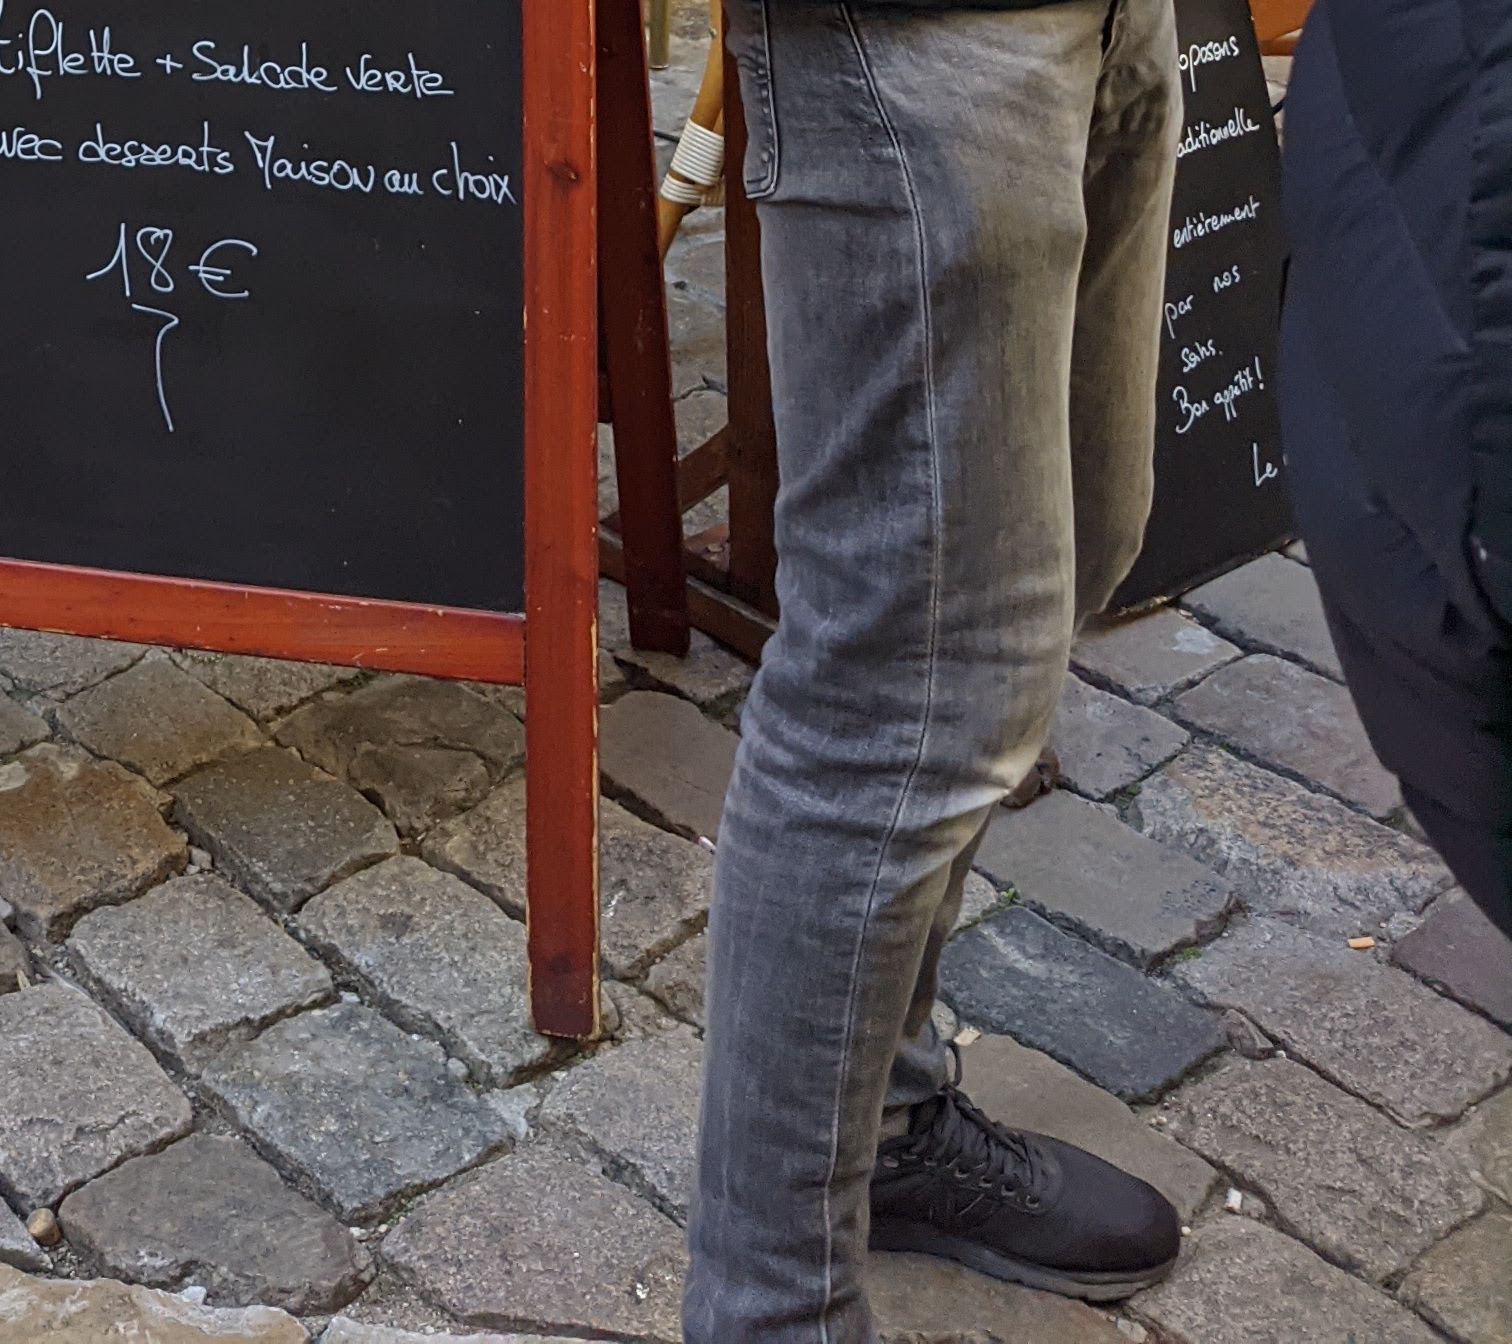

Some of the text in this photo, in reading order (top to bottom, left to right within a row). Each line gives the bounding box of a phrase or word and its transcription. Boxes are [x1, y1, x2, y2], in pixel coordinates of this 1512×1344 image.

[190, 41, 339, 93] Salade
[346, 52, 455, 99] verte
[1178, 35, 1240, 93] oposons
[1176, 106, 1260, 158] aditionnelle
[78, 122, 235, 175] desserts
[244, 130, 376, 190] Maison
[383, 168, 425, 195] au
[432, 141, 518, 205] choix
[1164, 264, 1241, 339] par nos
[1172, 386, 1210, 435] Bon
